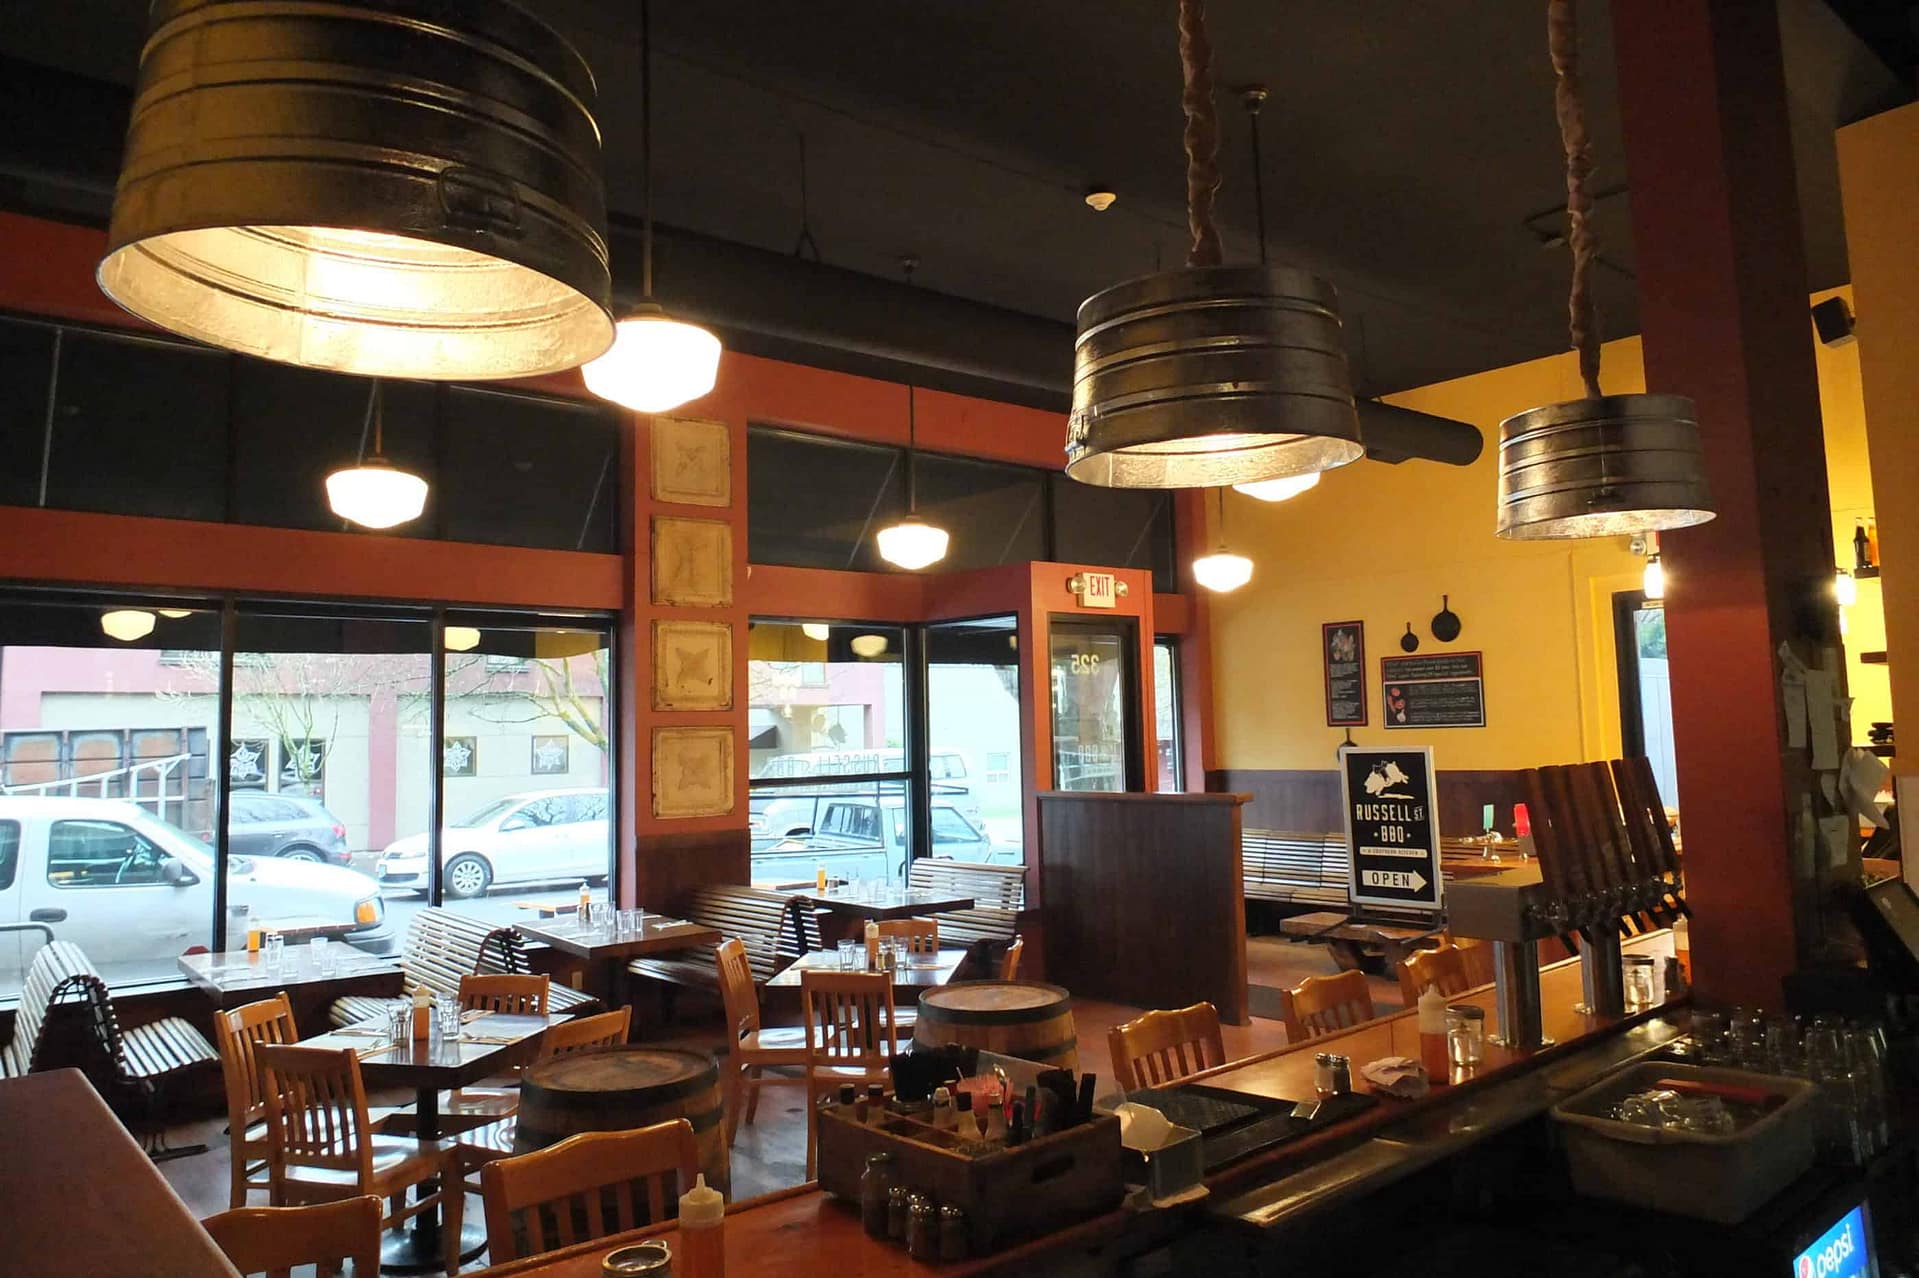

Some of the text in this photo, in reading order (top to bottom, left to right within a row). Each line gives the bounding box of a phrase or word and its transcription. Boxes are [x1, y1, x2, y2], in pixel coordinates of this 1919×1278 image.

[1090, 575, 1110, 597] EXIT
[1356, 804, 1411, 821] RUSSELL
[1381, 825, 1404, 843] BBQ
[1371, 871, 1411, 887] OPEN
[1816, 1223, 1855, 1278] pepsi
